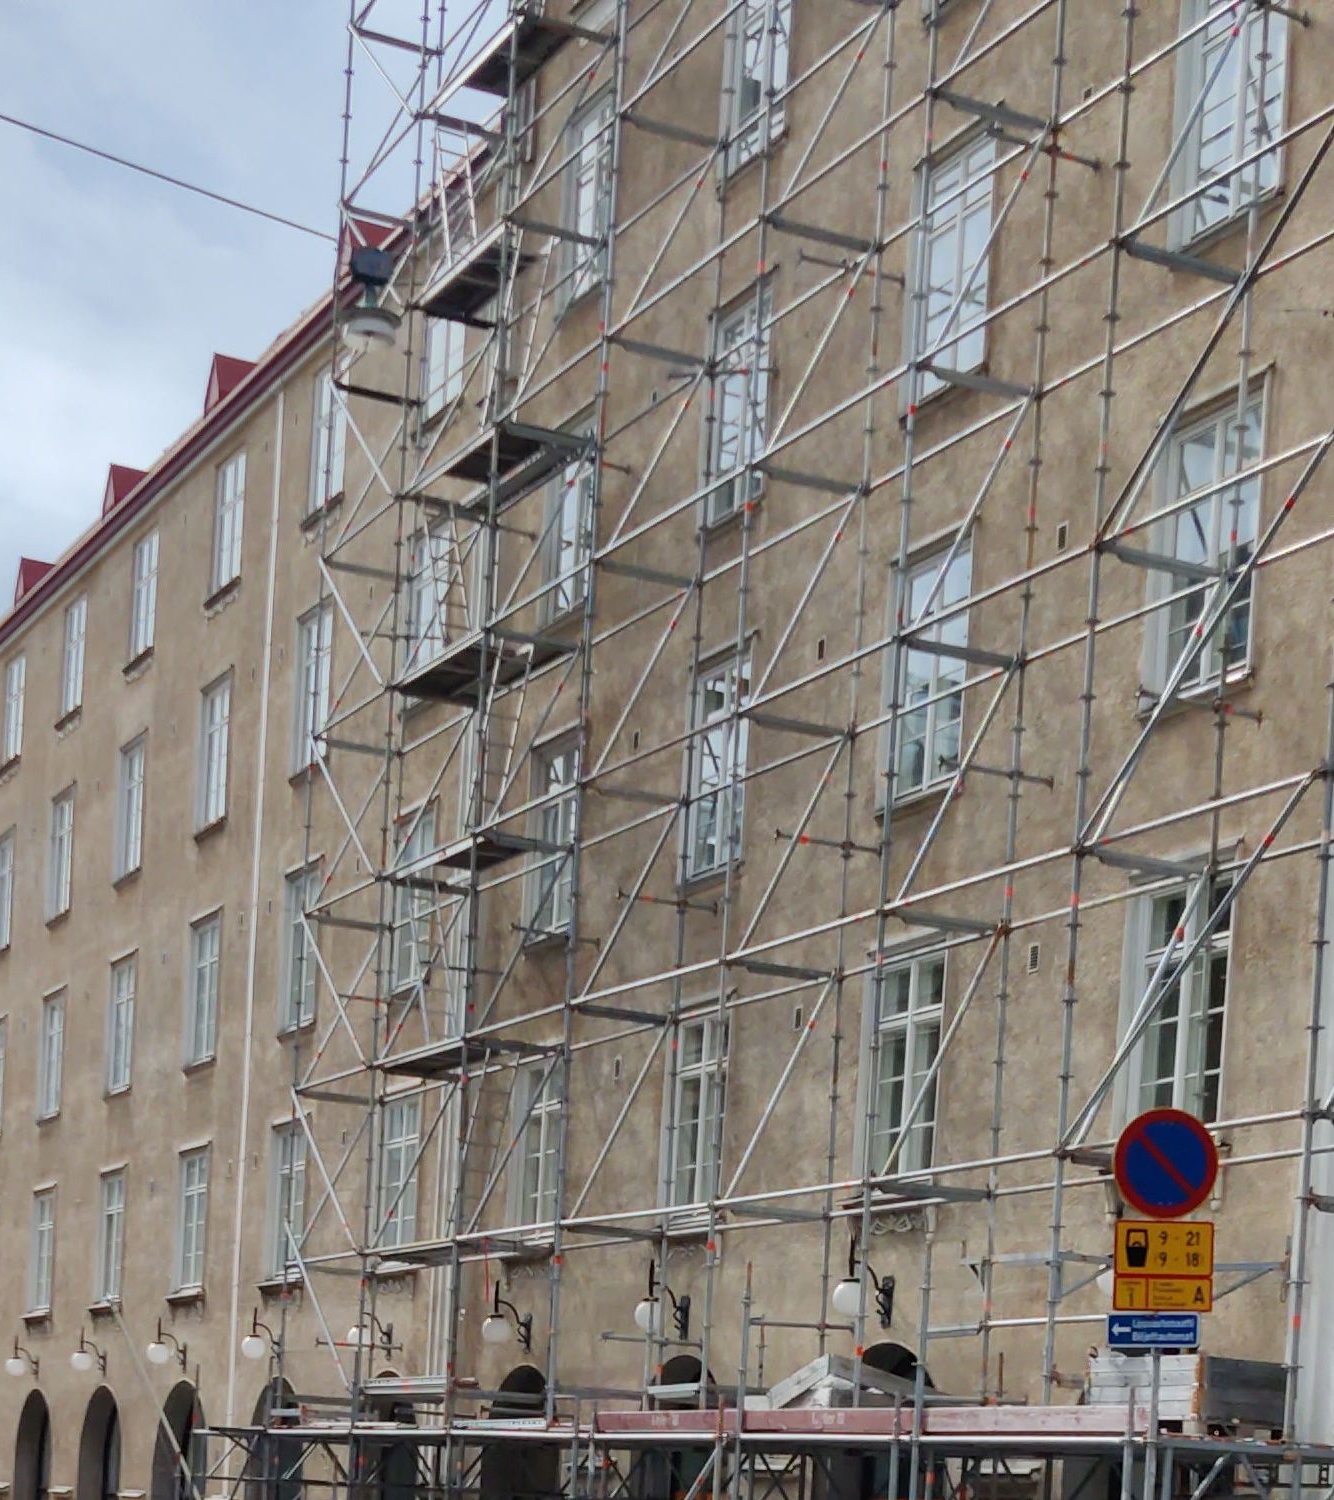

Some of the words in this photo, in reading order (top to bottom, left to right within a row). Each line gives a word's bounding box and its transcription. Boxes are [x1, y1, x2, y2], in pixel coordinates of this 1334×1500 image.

[1157, 1231, 1169, 1246] 9
[1185, 1231, 1201, 1247] 21
[1192, 1286, 1205, 1305] A
